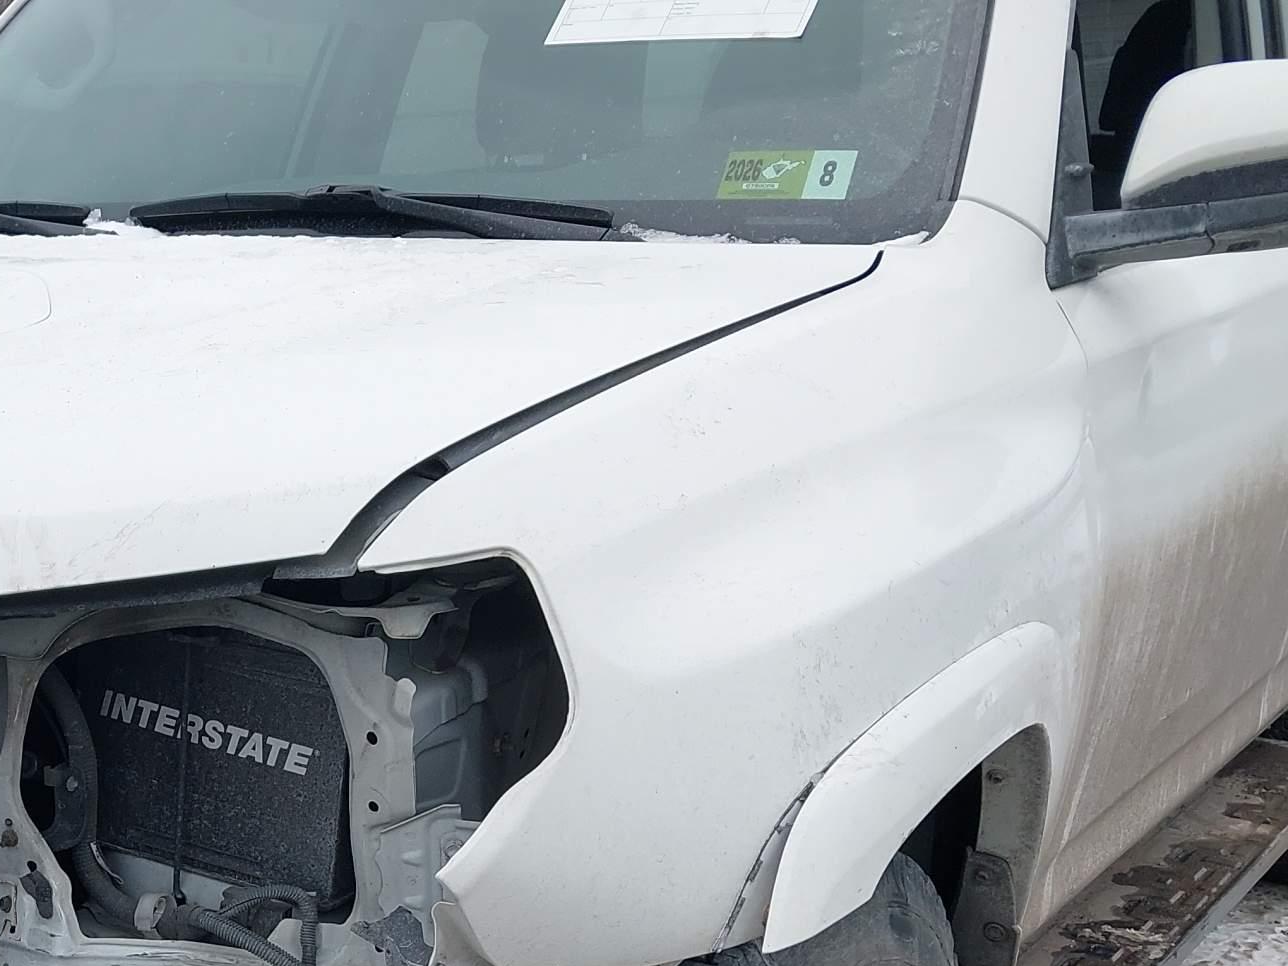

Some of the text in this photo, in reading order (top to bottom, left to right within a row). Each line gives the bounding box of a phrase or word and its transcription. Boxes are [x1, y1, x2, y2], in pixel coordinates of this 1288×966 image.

[724, 159, 763, 182] 2026
[819, 160, 838, 187] 8
[99, 689, 314, 776] INTERSTATE
